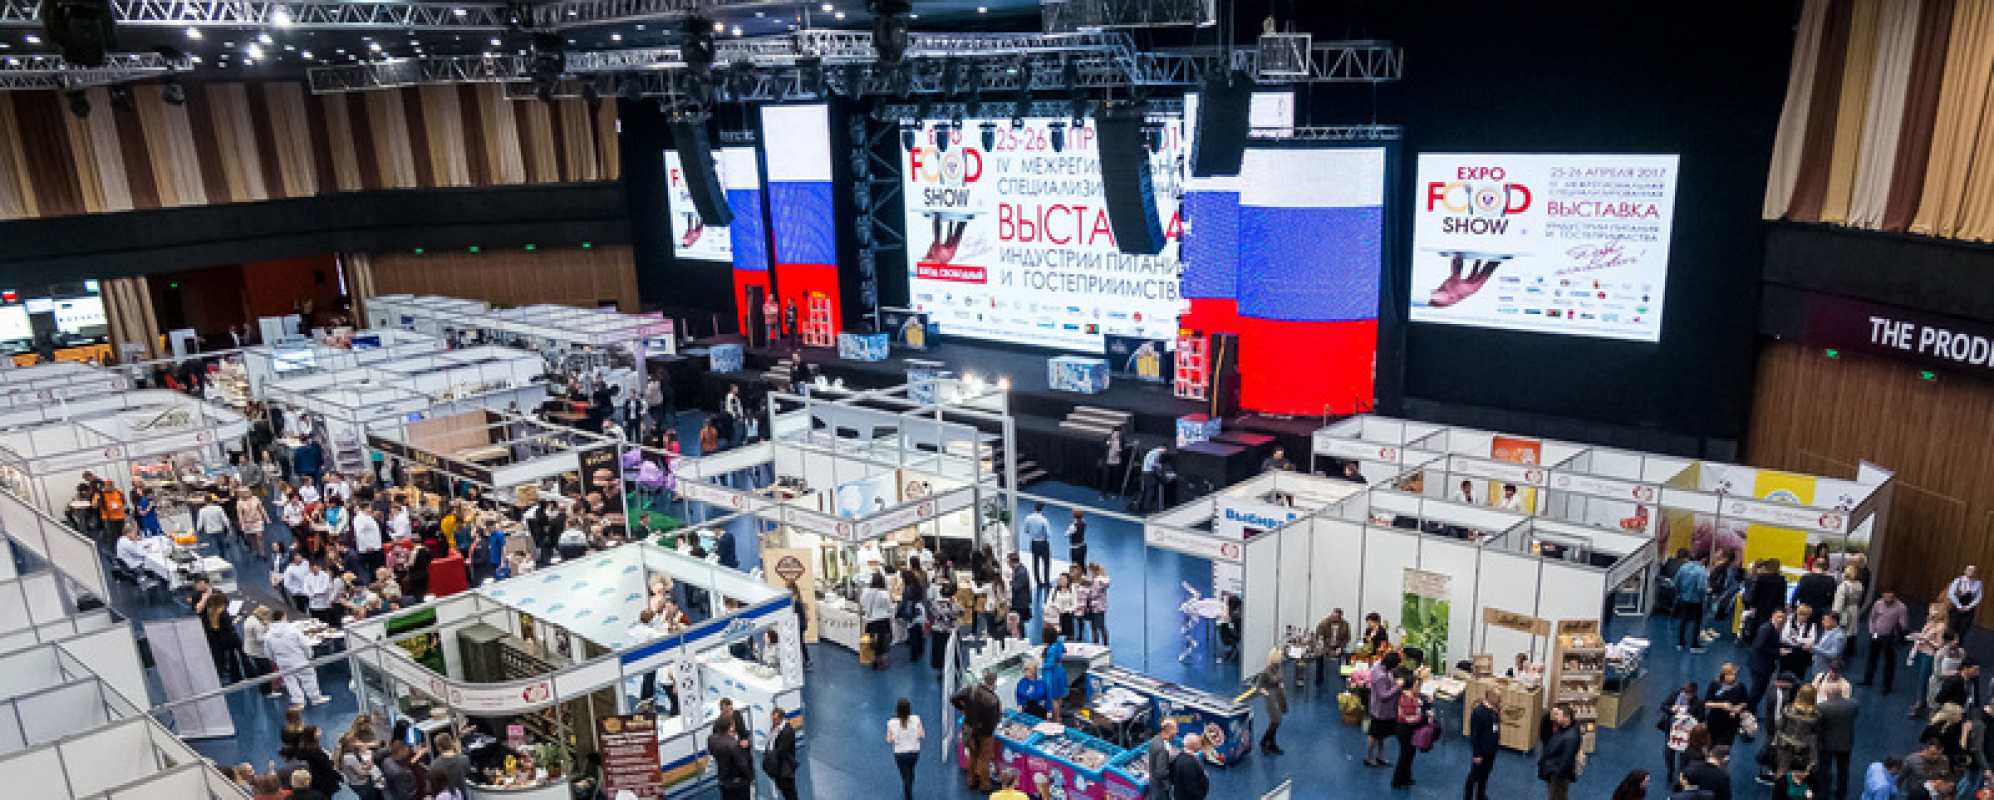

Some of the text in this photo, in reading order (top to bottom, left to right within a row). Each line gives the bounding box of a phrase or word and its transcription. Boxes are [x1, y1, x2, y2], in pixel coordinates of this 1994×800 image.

[996, 126, 1047, 150] 25-26
[1457, 166, 1506, 181] EXPO
[923, 186, 971, 207] SHOW
[1426, 181, 1534, 215] FOOD
[1546, 200, 1661, 219] ВЫСТАВКА
[998, 202, 1184, 248] ВЫСТАА
[1442, 216, 1509, 235] SHOW
[1000, 248, 1184, 275] ИНДУСТРИИ ПИТАНИ
[1001, 270, 1182, 302] И ГОСТЕПРИИМСТВ
[1868, 316, 1915, 349] THE
